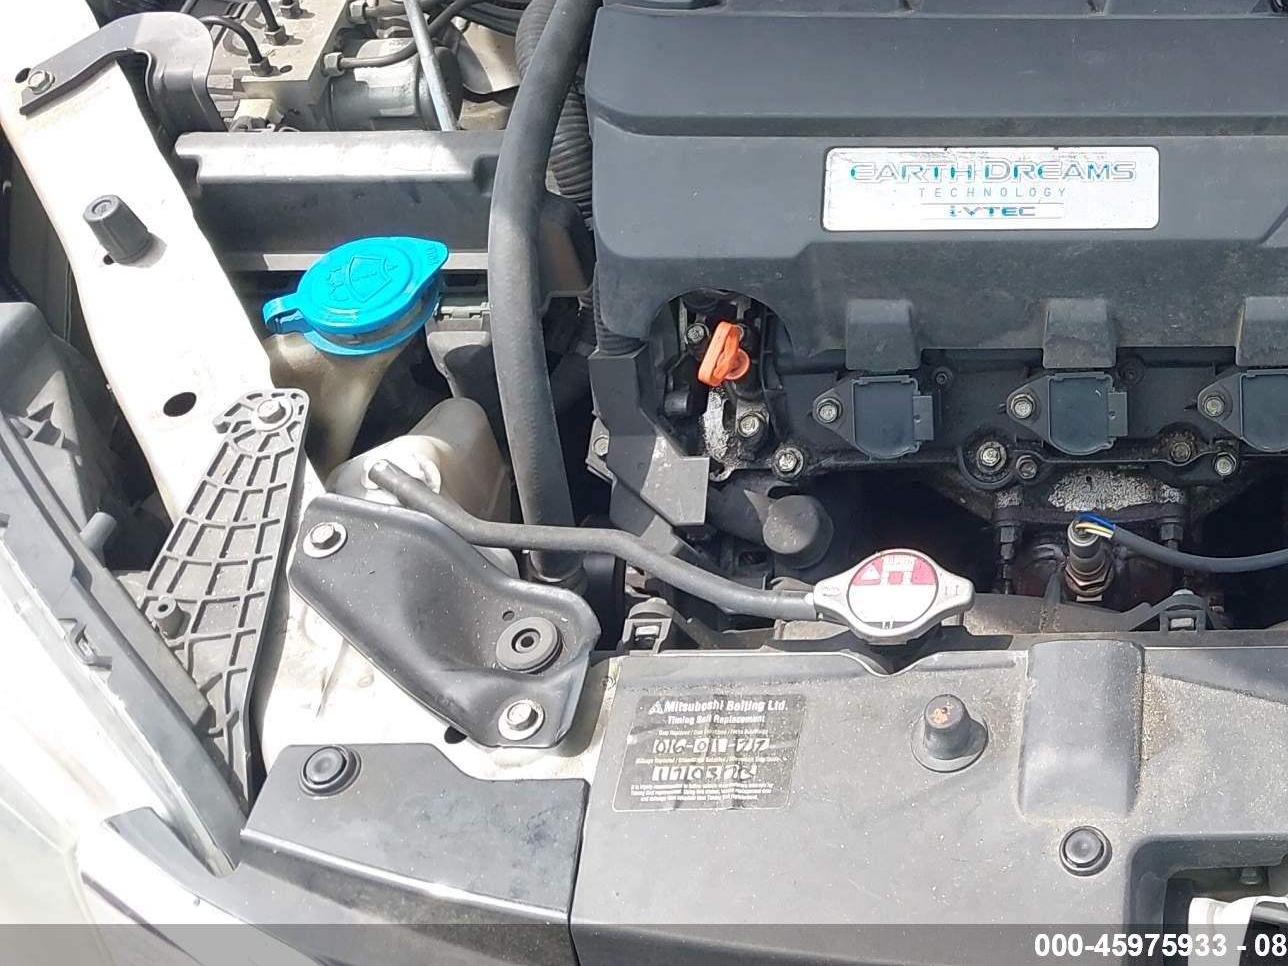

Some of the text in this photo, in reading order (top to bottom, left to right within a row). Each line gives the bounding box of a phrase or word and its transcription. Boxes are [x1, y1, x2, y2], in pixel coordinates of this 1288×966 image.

[850, 160, 1136, 182] EARTH DREAMS
[919, 187, 1067, 198] TECHNOLOGY
[949, 205, 1036, 218] i-VTEC
[664, 699, 724, 713] Mitsuboshi
[768, 699, 788, 711] Ltd.
[667, 715, 695, 726] Timing
[713, 714, 766, 725] Replacement
